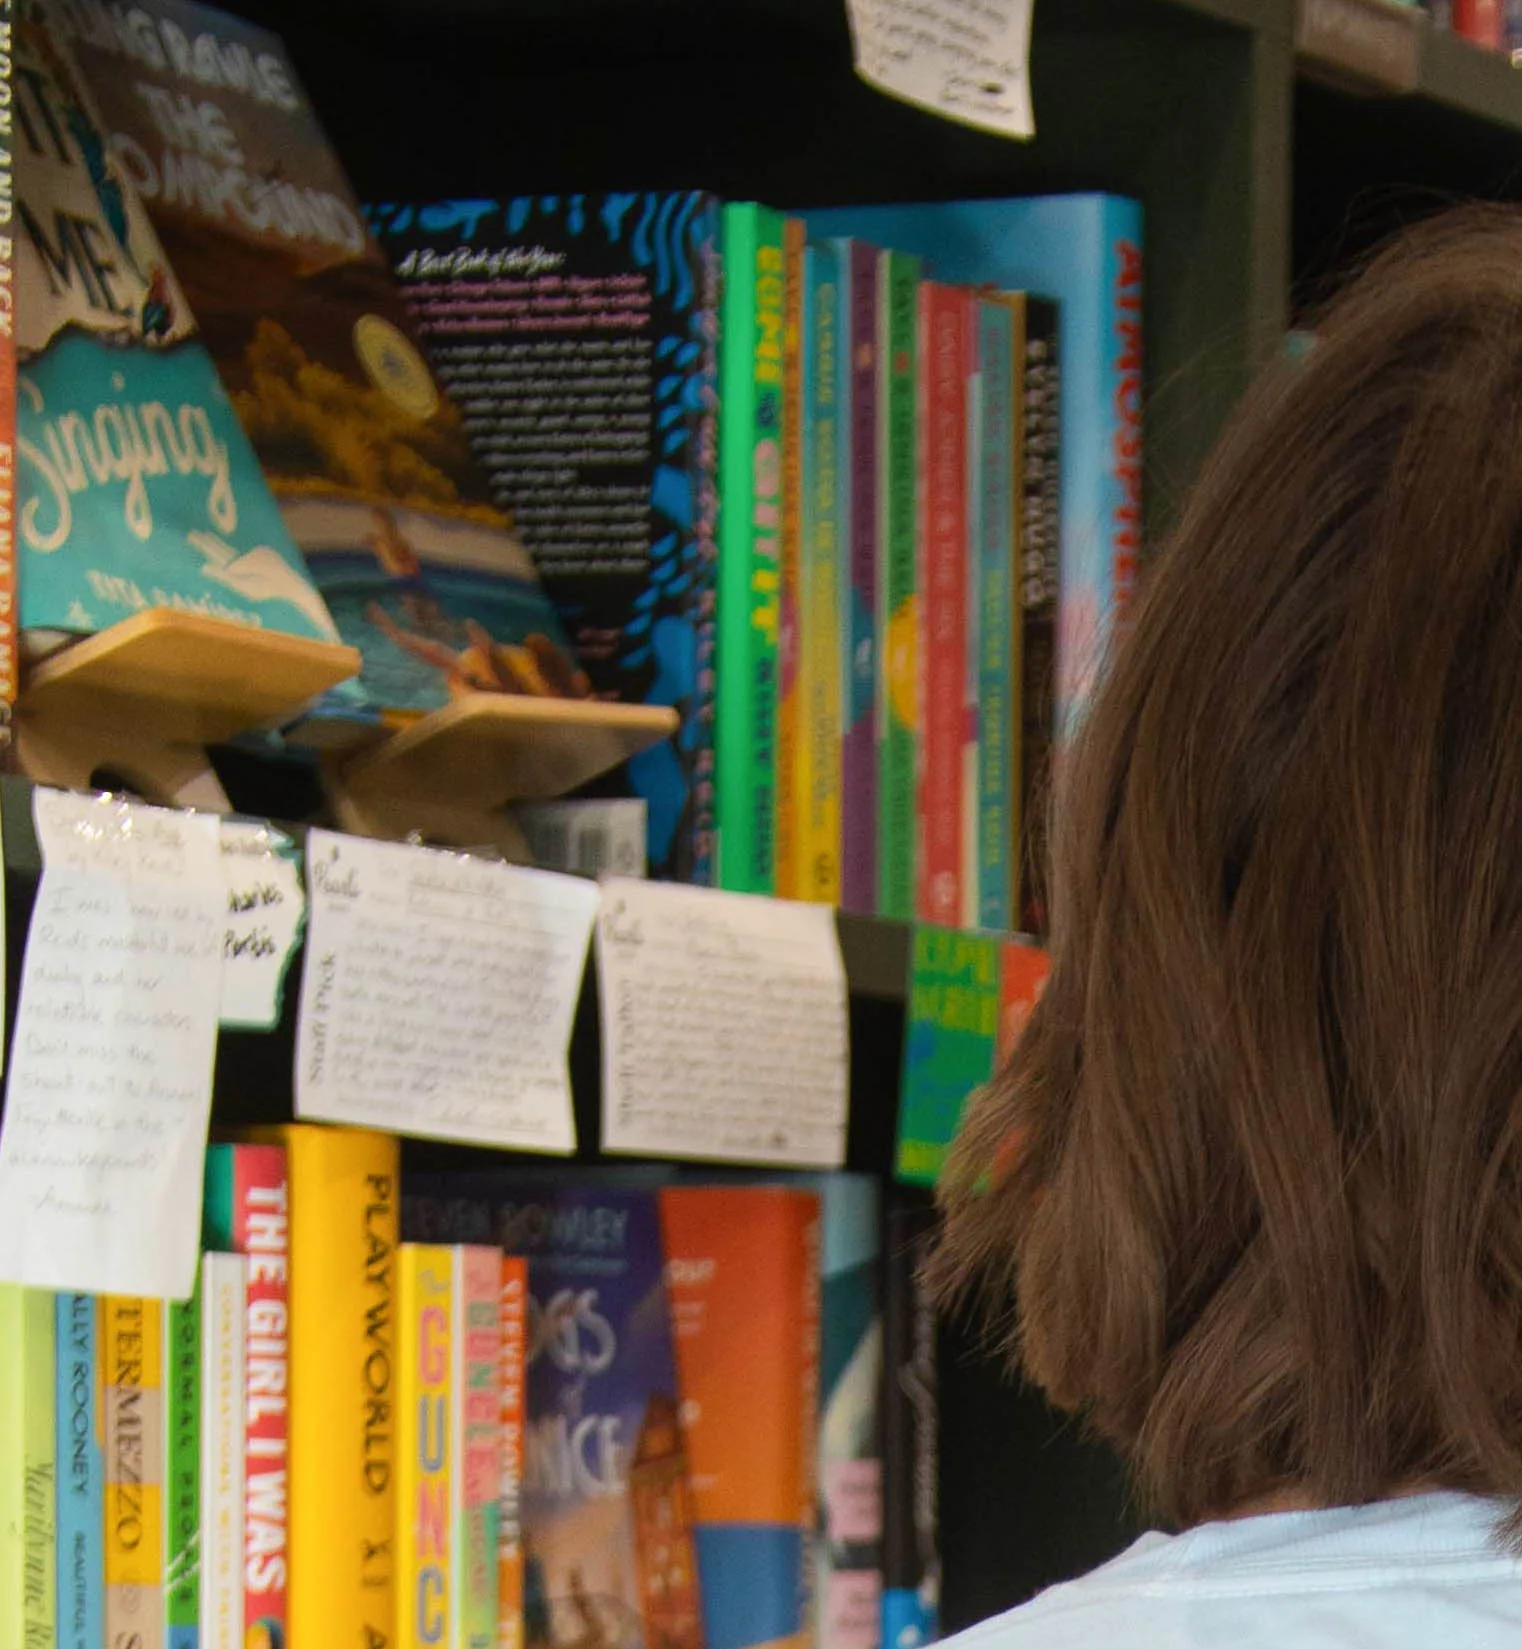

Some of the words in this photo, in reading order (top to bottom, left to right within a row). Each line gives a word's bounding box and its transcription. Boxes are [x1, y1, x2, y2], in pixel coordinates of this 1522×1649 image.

[1112, 238, 1142, 606] ATMOSPHE
[247, 1183, 288, 1283] THE
[72, 1294, 90, 1354] ALLY
[179, 1300, 197, 1451] NORMAL
[247, 1299, 288, 1424] GIRL
[364, 1172, 391, 1496] PLAYWORLD
[72, 1360, 90, 1498] ROONEY
[114, 1297, 145, 1553] TERMEZZO
[247, 1436, 288, 1460] I
[74, 1530, 88, 1633] BEAUTIFUL
[245, 1469, 287, 1593] WAS
